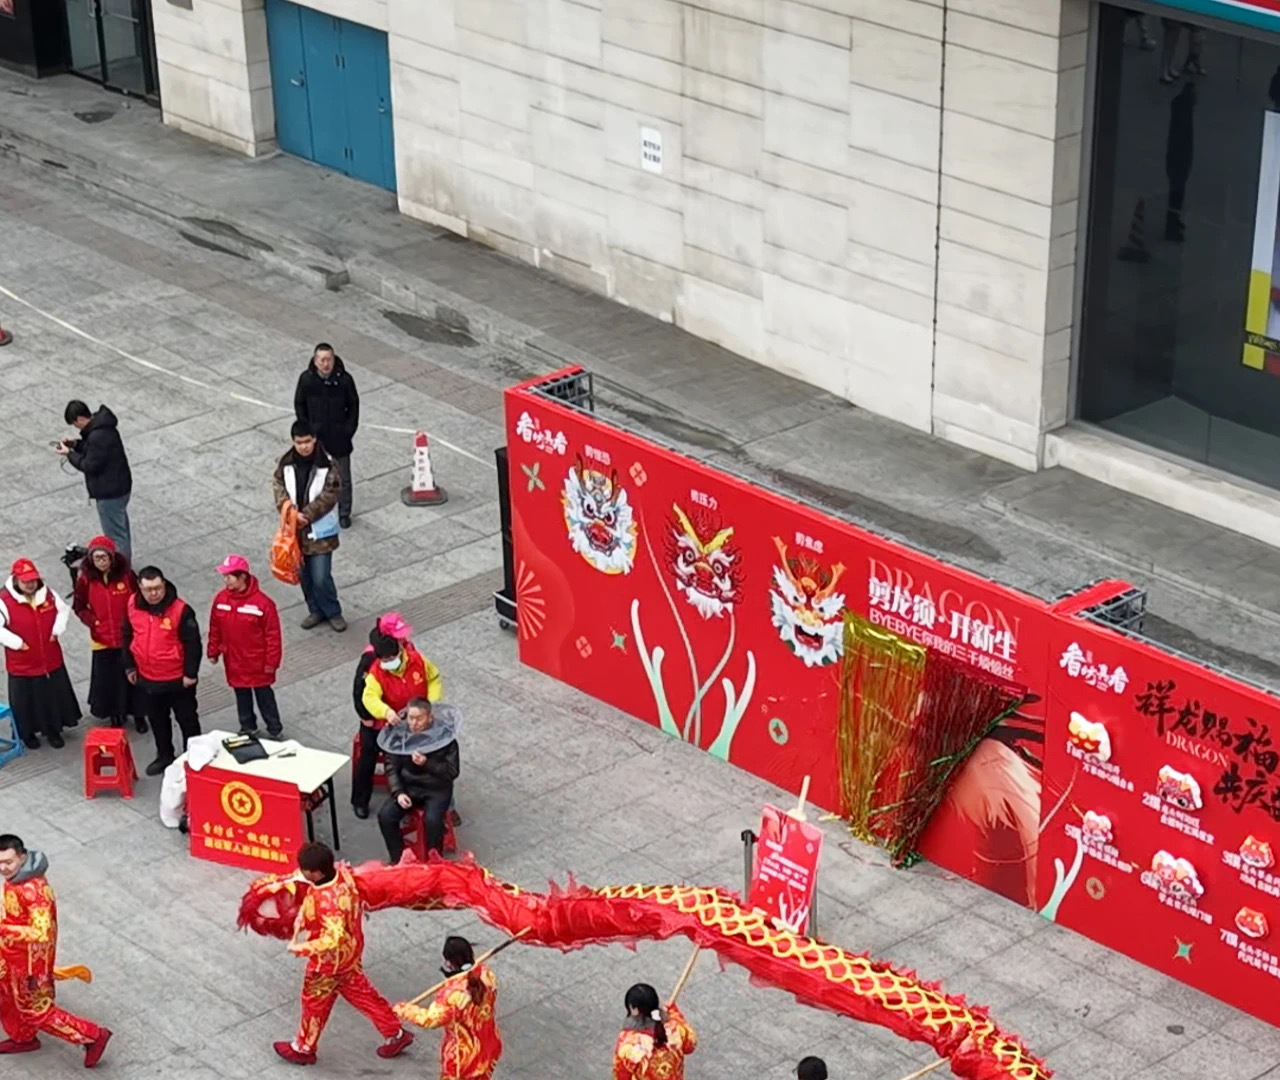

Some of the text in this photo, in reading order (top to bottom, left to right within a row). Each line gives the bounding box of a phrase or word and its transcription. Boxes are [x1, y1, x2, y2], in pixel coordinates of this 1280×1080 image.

[1135, 679, 1280, 776] 祥龙赐福
[1166, 730, 1229, 769] DRAGON
